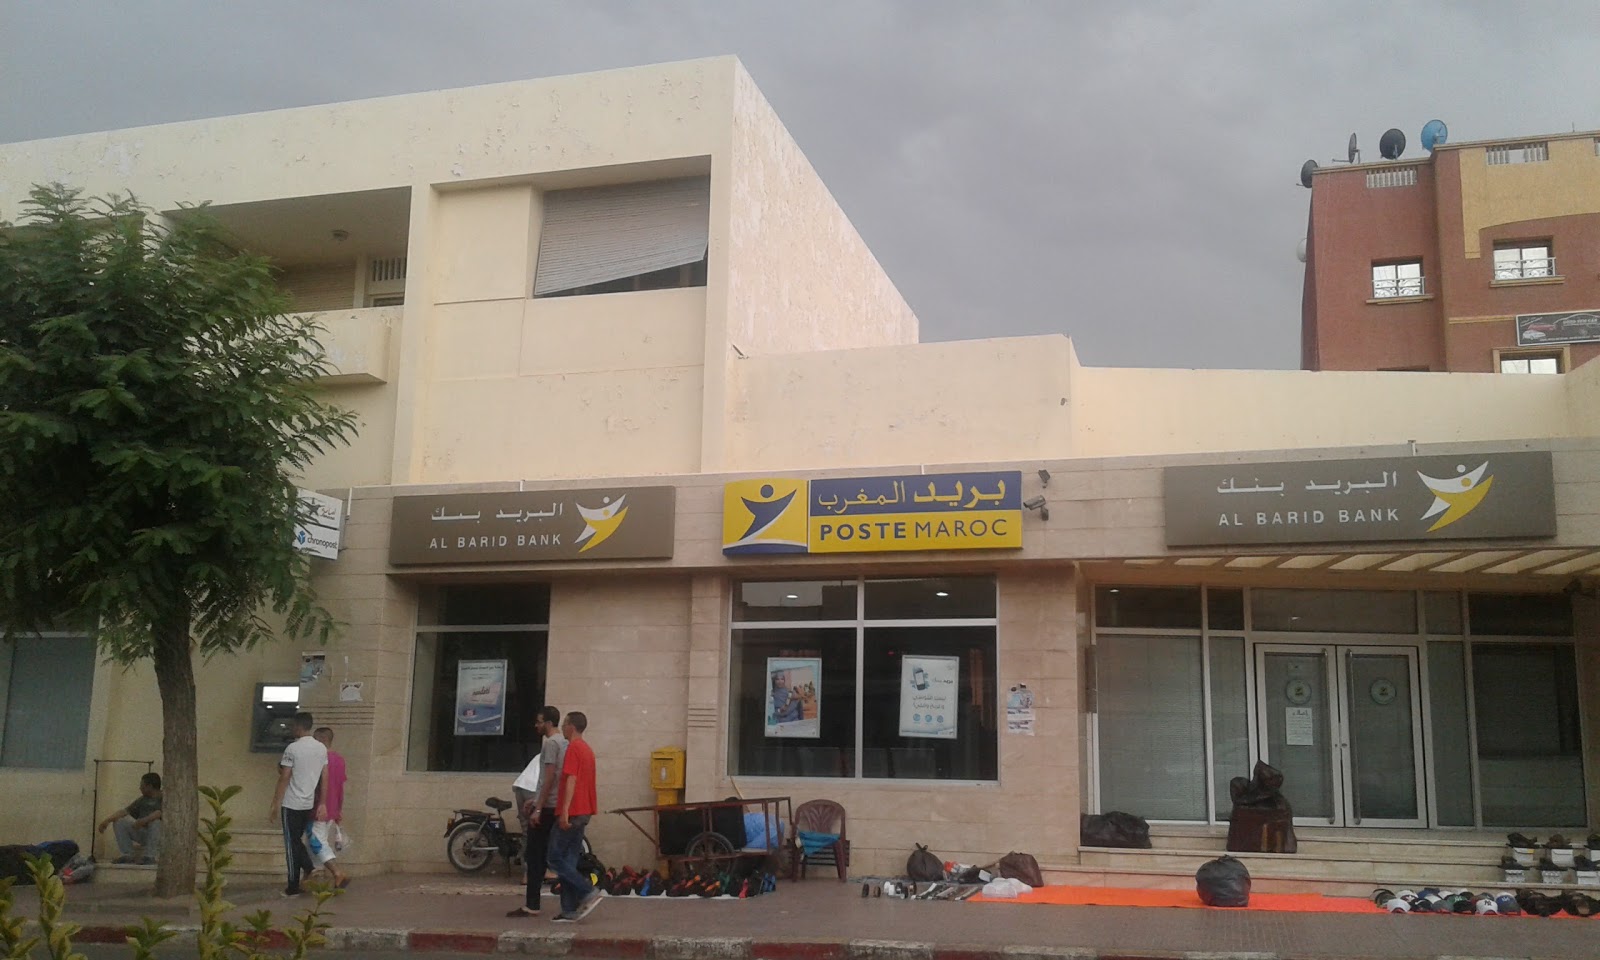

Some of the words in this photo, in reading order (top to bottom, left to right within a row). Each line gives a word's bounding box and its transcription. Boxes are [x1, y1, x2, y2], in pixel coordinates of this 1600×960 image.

[914, 479, 1006, 508] بريد
[1217, 476, 1285, 497] بنك
[1305, 471, 1398, 496] البريد
[818, 480, 906, 515] المغرب
[496, 502, 564, 523] البريد
[1218, 512, 1243, 527] AL
[1257, 510, 1324, 525] BARID
[1339, 508, 1400, 523] BANK
[820, 521, 907, 541] POSTE
[915, 518, 1008, 538] MAROC
[307, 537, 338, 549] chronopost
[429, 537, 448, 549] AL
[457, 535, 508, 548] BARID
[517, 533, 561, 546] BANK
